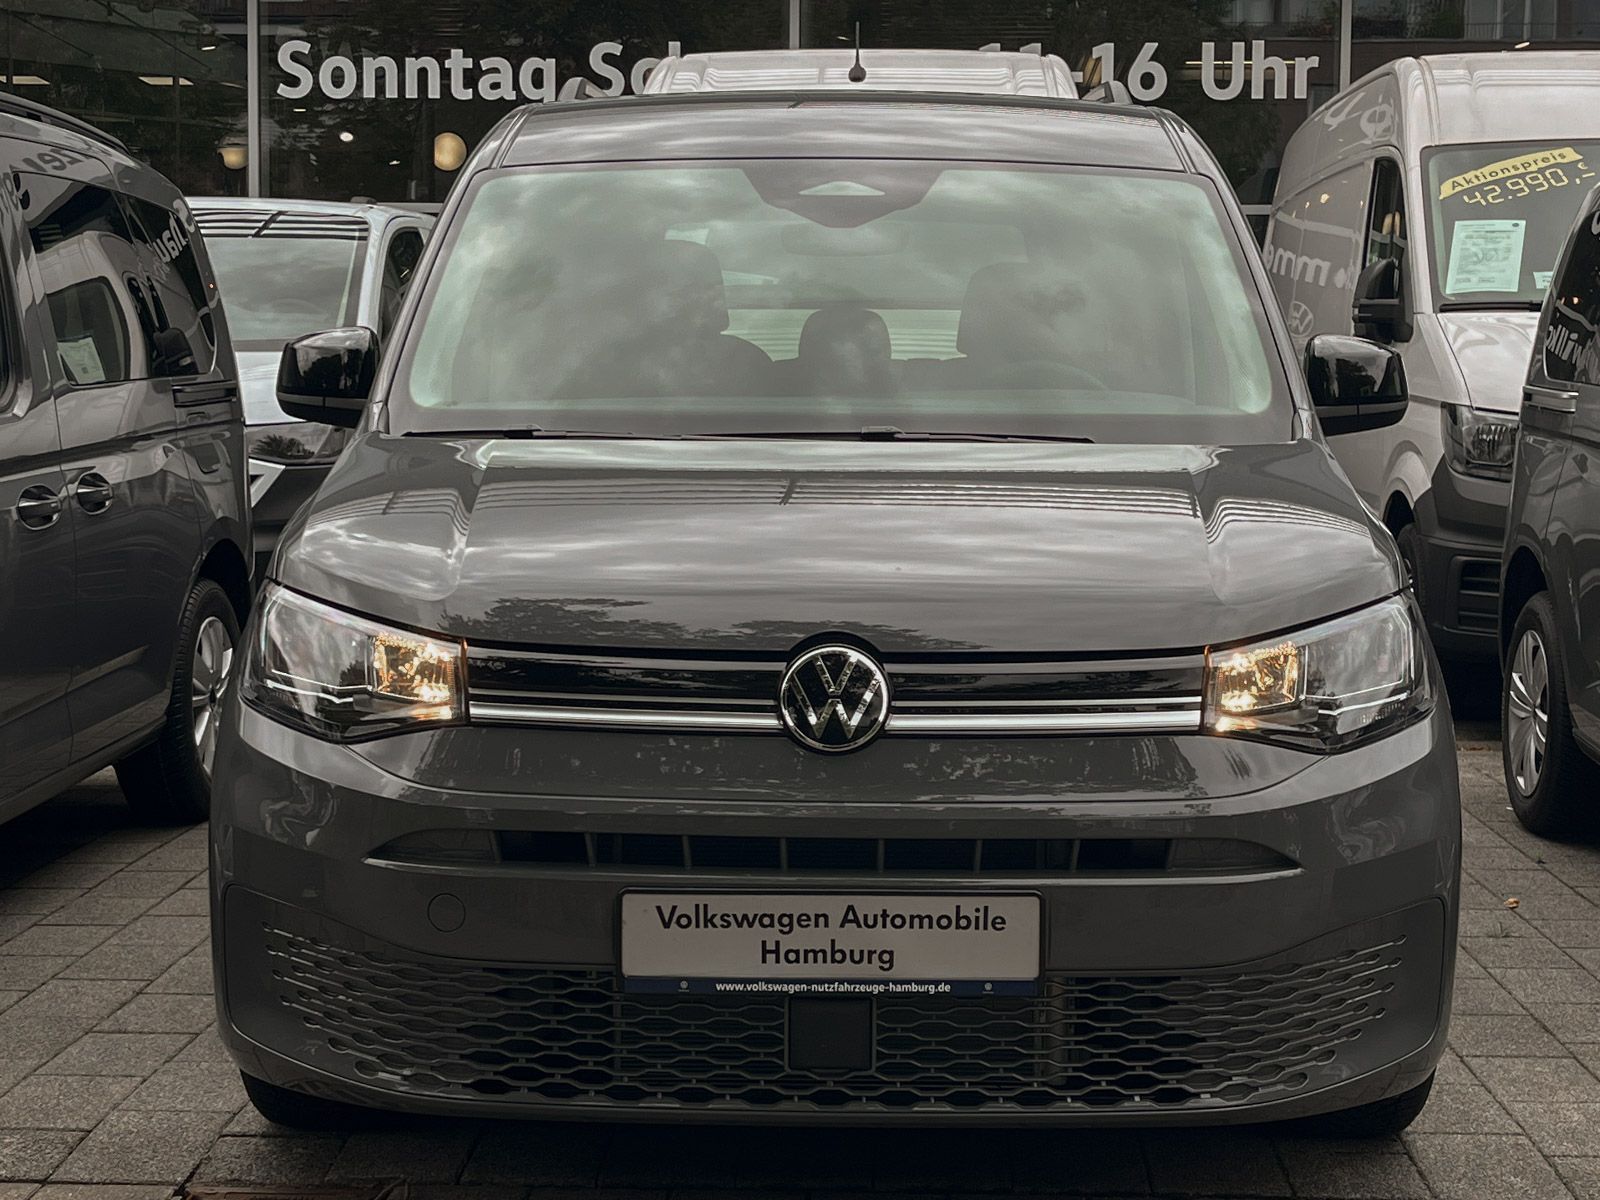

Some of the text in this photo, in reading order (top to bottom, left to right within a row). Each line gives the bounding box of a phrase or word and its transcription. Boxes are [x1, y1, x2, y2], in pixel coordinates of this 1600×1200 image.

[277, 40, 556, 102] Sonntag
[589, 41, 681, 97] Sc
[1202, 40, 1319, 100] Uhr
[1451, 151, 1567, 191] Aktionspreis
[655, 903, 1007, 935] Volkswagen Automobile
[760, 938, 896, 971] Hamburg
[715, 981, 951, 995] www.volkswagen-nutzfahrzeuge-hamburg.de
